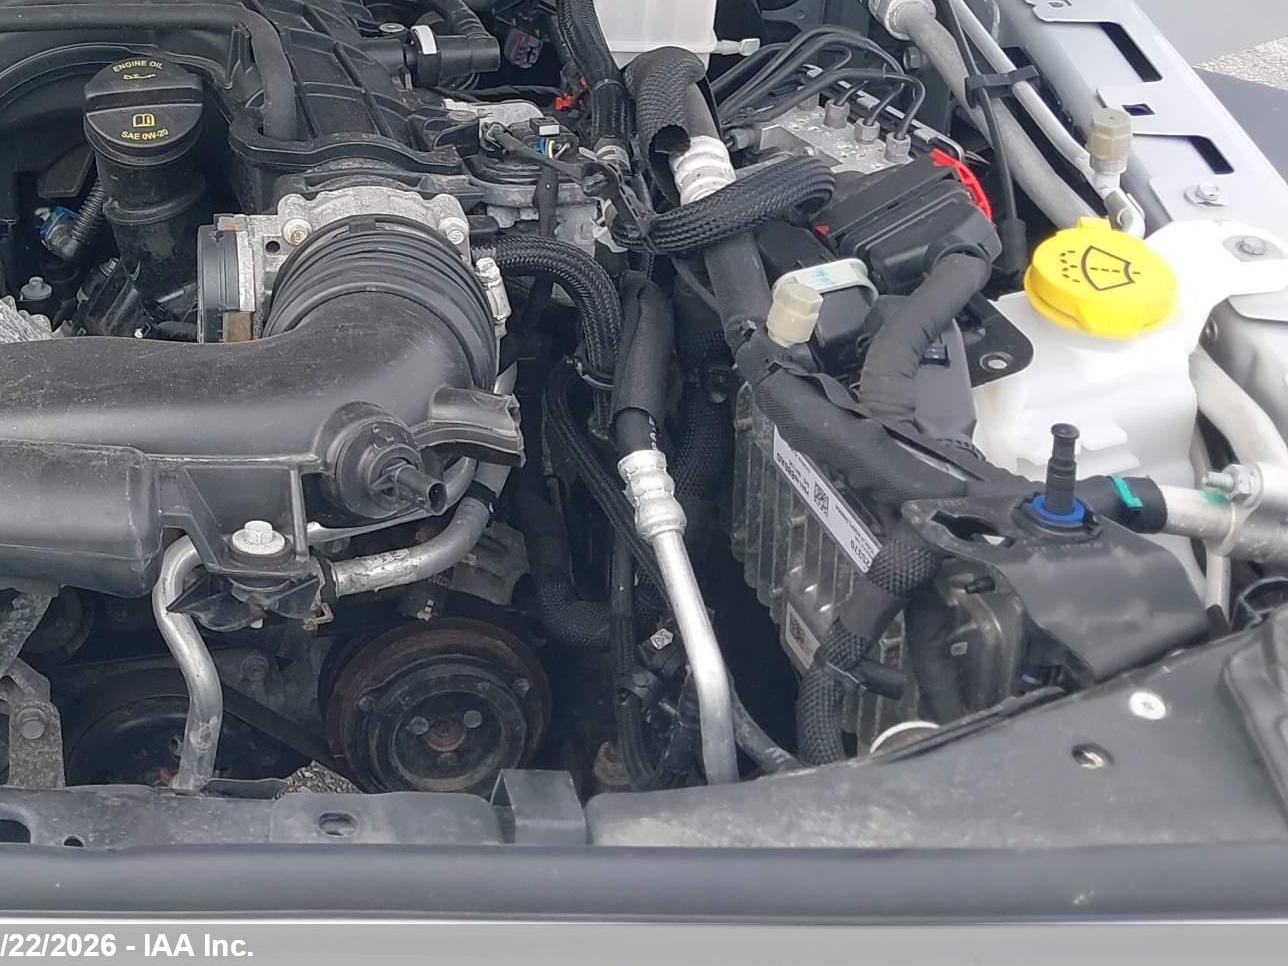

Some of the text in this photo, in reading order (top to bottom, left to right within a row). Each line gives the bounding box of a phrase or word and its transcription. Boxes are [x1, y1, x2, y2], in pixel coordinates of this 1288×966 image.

[112, 60, 164, 73] ENGINE OIL
[121, 128, 169, 140] SAE 0W-20
